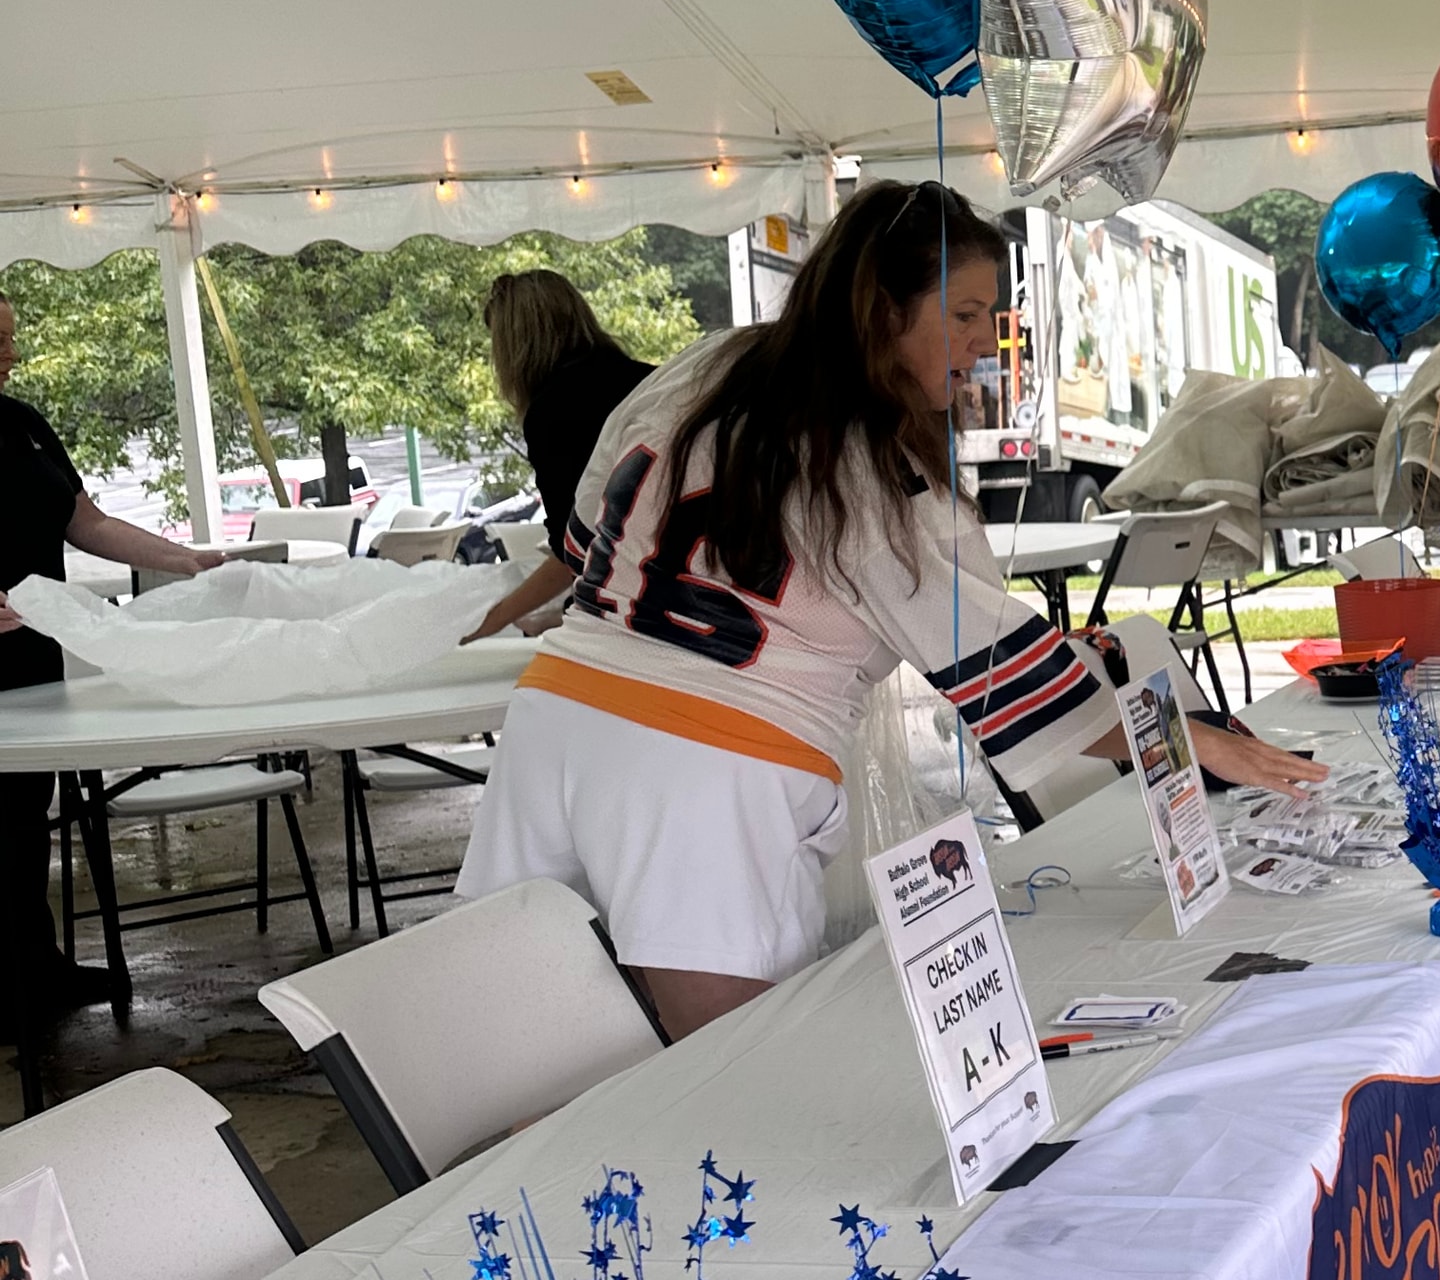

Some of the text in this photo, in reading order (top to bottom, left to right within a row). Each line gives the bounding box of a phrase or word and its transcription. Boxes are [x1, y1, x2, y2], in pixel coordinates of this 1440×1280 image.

[574, 443, 796, 670] 16
[888, 861, 911, 883] Buffalo
[910, 854, 928, 869] Grove
[893, 873, 929, 902] High School
[900, 885, 949, 920] Alumni Foundation
[927, 932, 988, 989] CHECK IN
[934, 969, 1003, 1035] LAST NAME
[963, 1047, 982, 1092] A
[989, 1021, 1011, 1067] K
